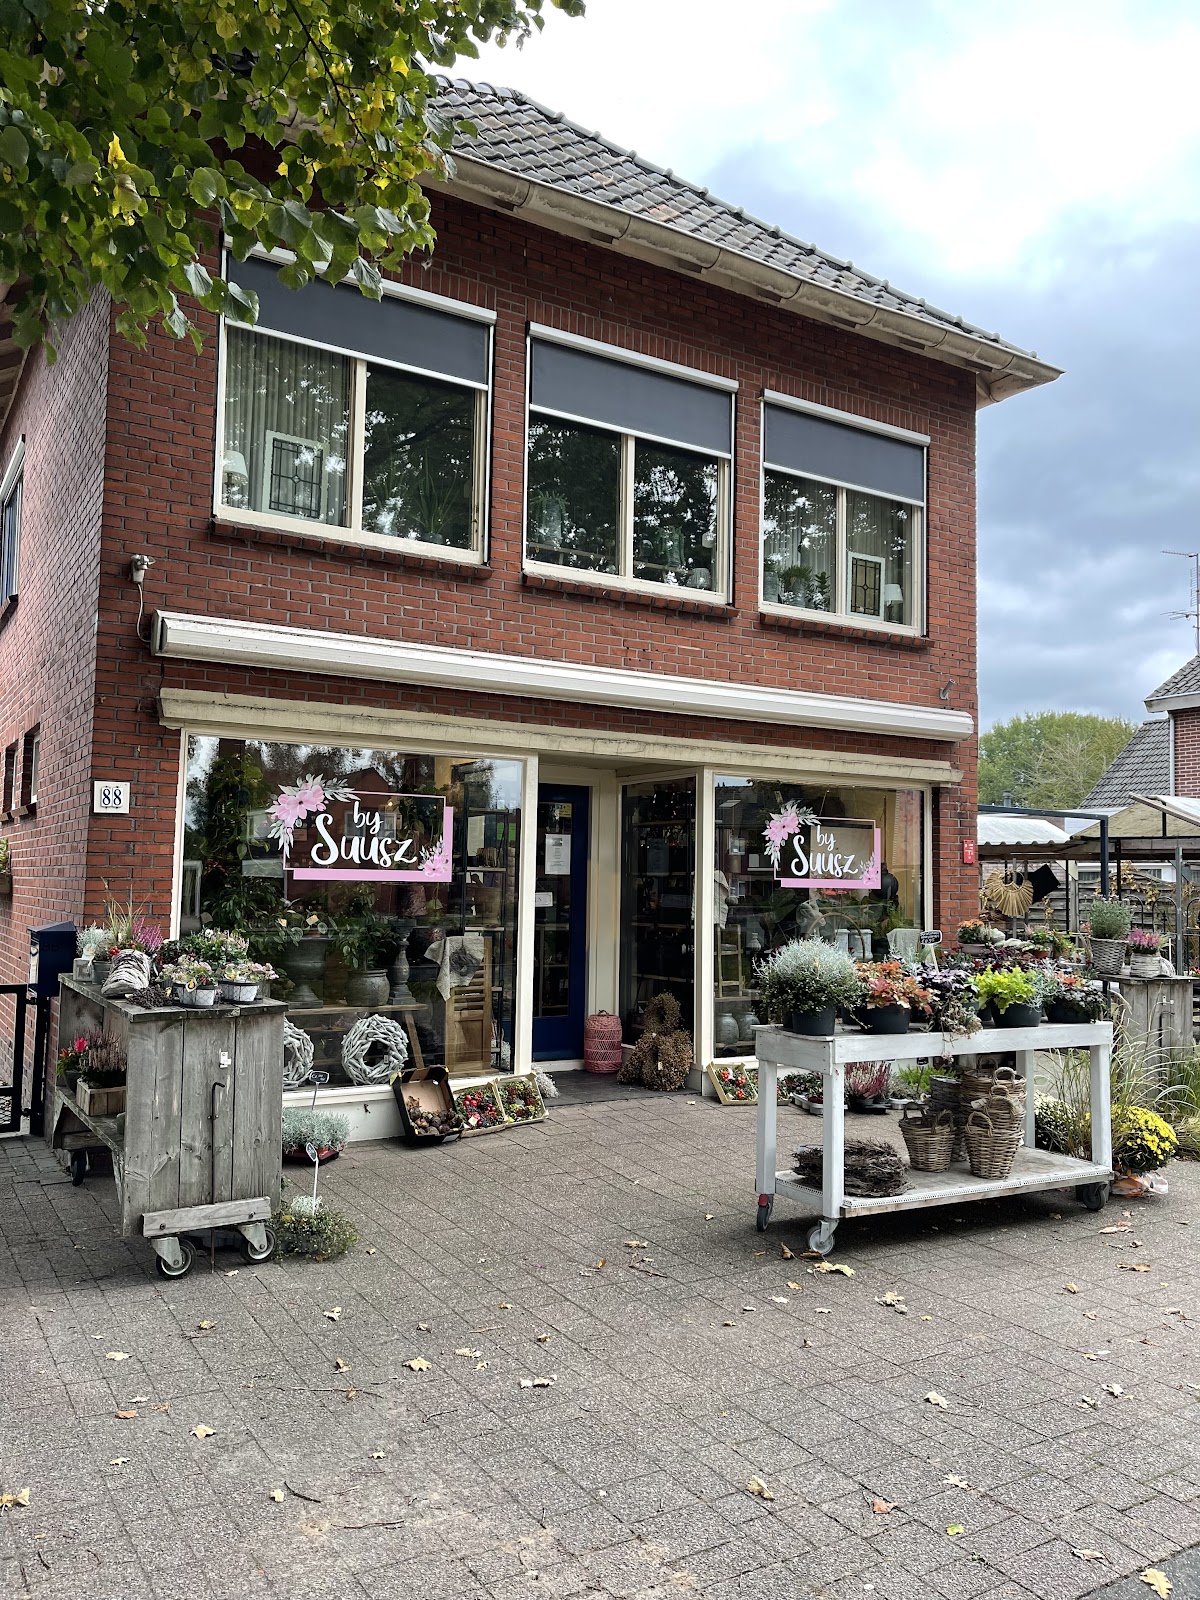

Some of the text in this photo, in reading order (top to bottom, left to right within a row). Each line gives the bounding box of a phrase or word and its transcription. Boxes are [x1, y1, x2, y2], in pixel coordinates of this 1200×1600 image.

[103, 789, 121, 805] 88
[353, 801, 384, 834] by
[310, 813, 418, 868] Suusz
[816, 825, 836, 851] by
[791, 835, 858, 877] Suusz
